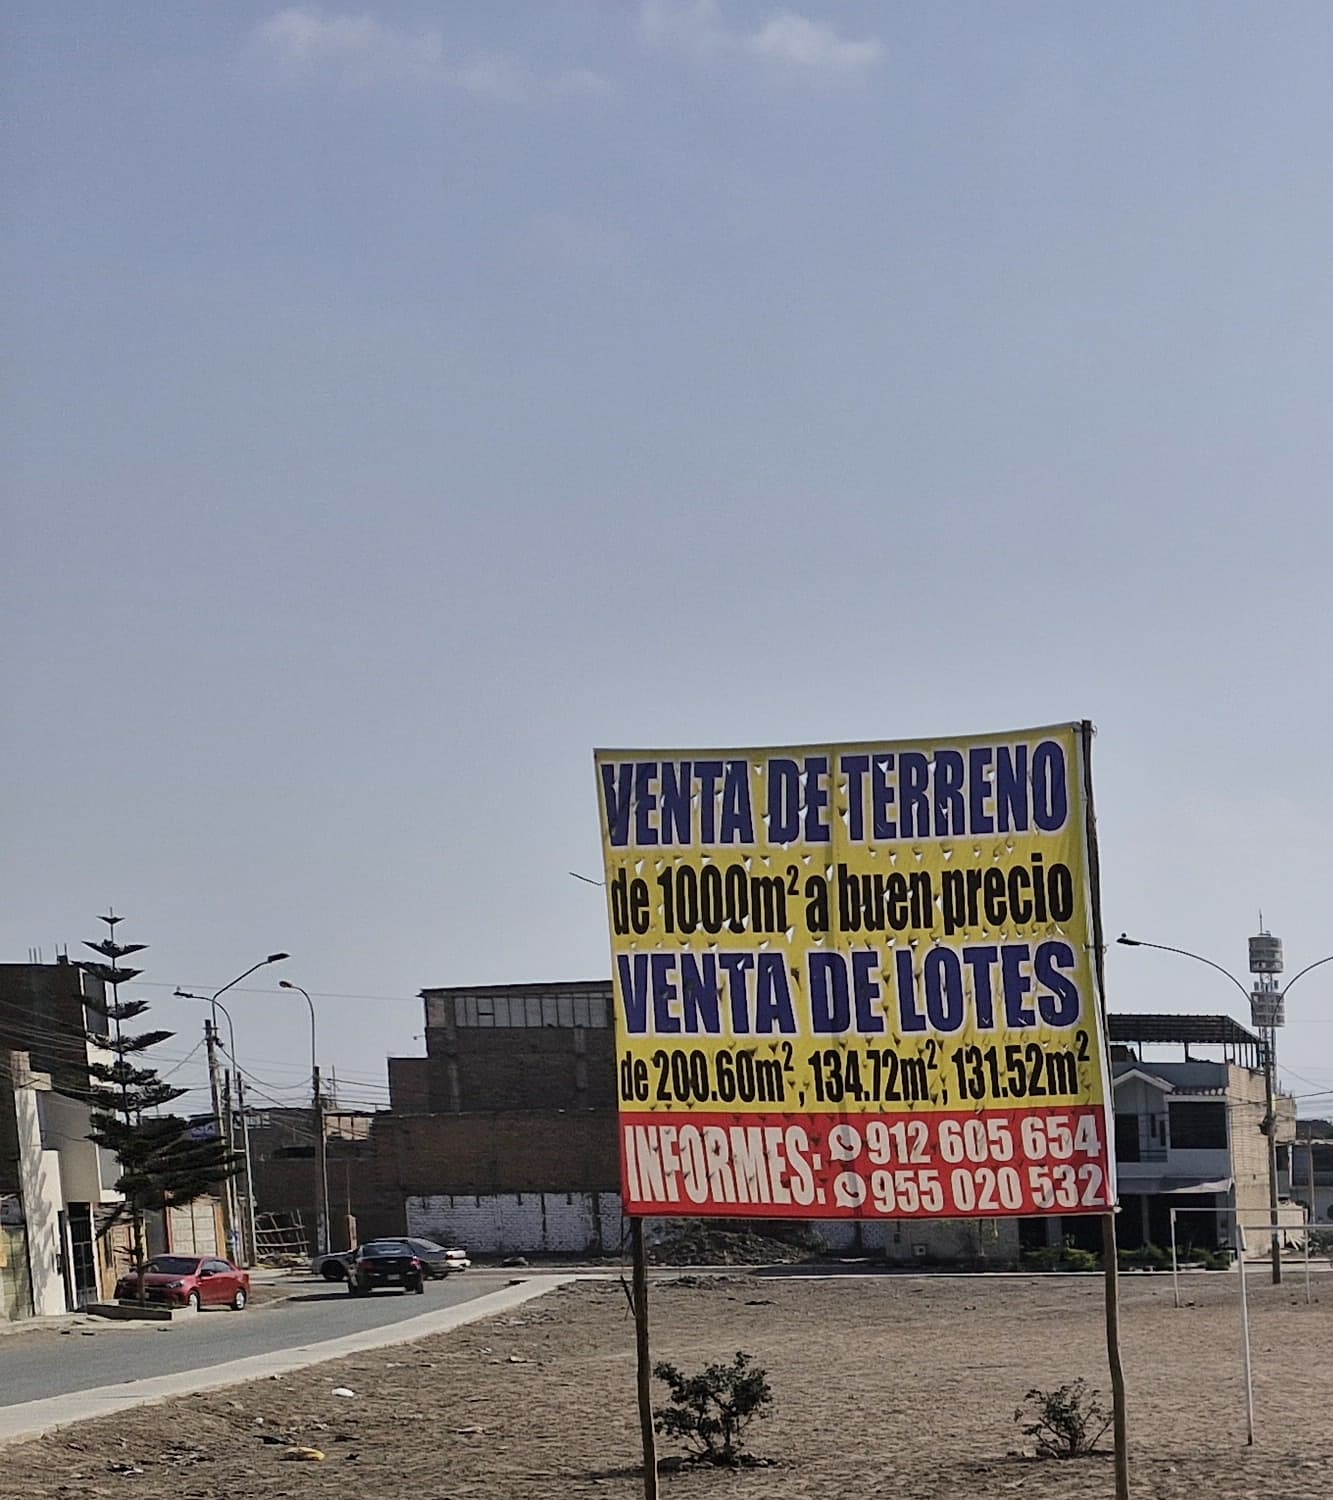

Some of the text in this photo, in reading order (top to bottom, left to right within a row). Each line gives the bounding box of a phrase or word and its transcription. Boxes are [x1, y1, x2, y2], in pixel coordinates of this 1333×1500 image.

[601, 741, 1068, 847] VENTA DE TERRENO
[611, 867, 649, 936] de
[805, 876, 830, 933] a
[838, 867, 934, 934] buen
[941, 853, 1074, 936] precio
[617, 941, 1081, 1035] VENTA DE LOTES
[621, 1052, 648, 1102] de
[624, 1124, 826, 1206] INFORMES:
[866, 1114, 1100, 1166] 912 605 654
[872, 1163, 1106, 1214] 955 020 532
